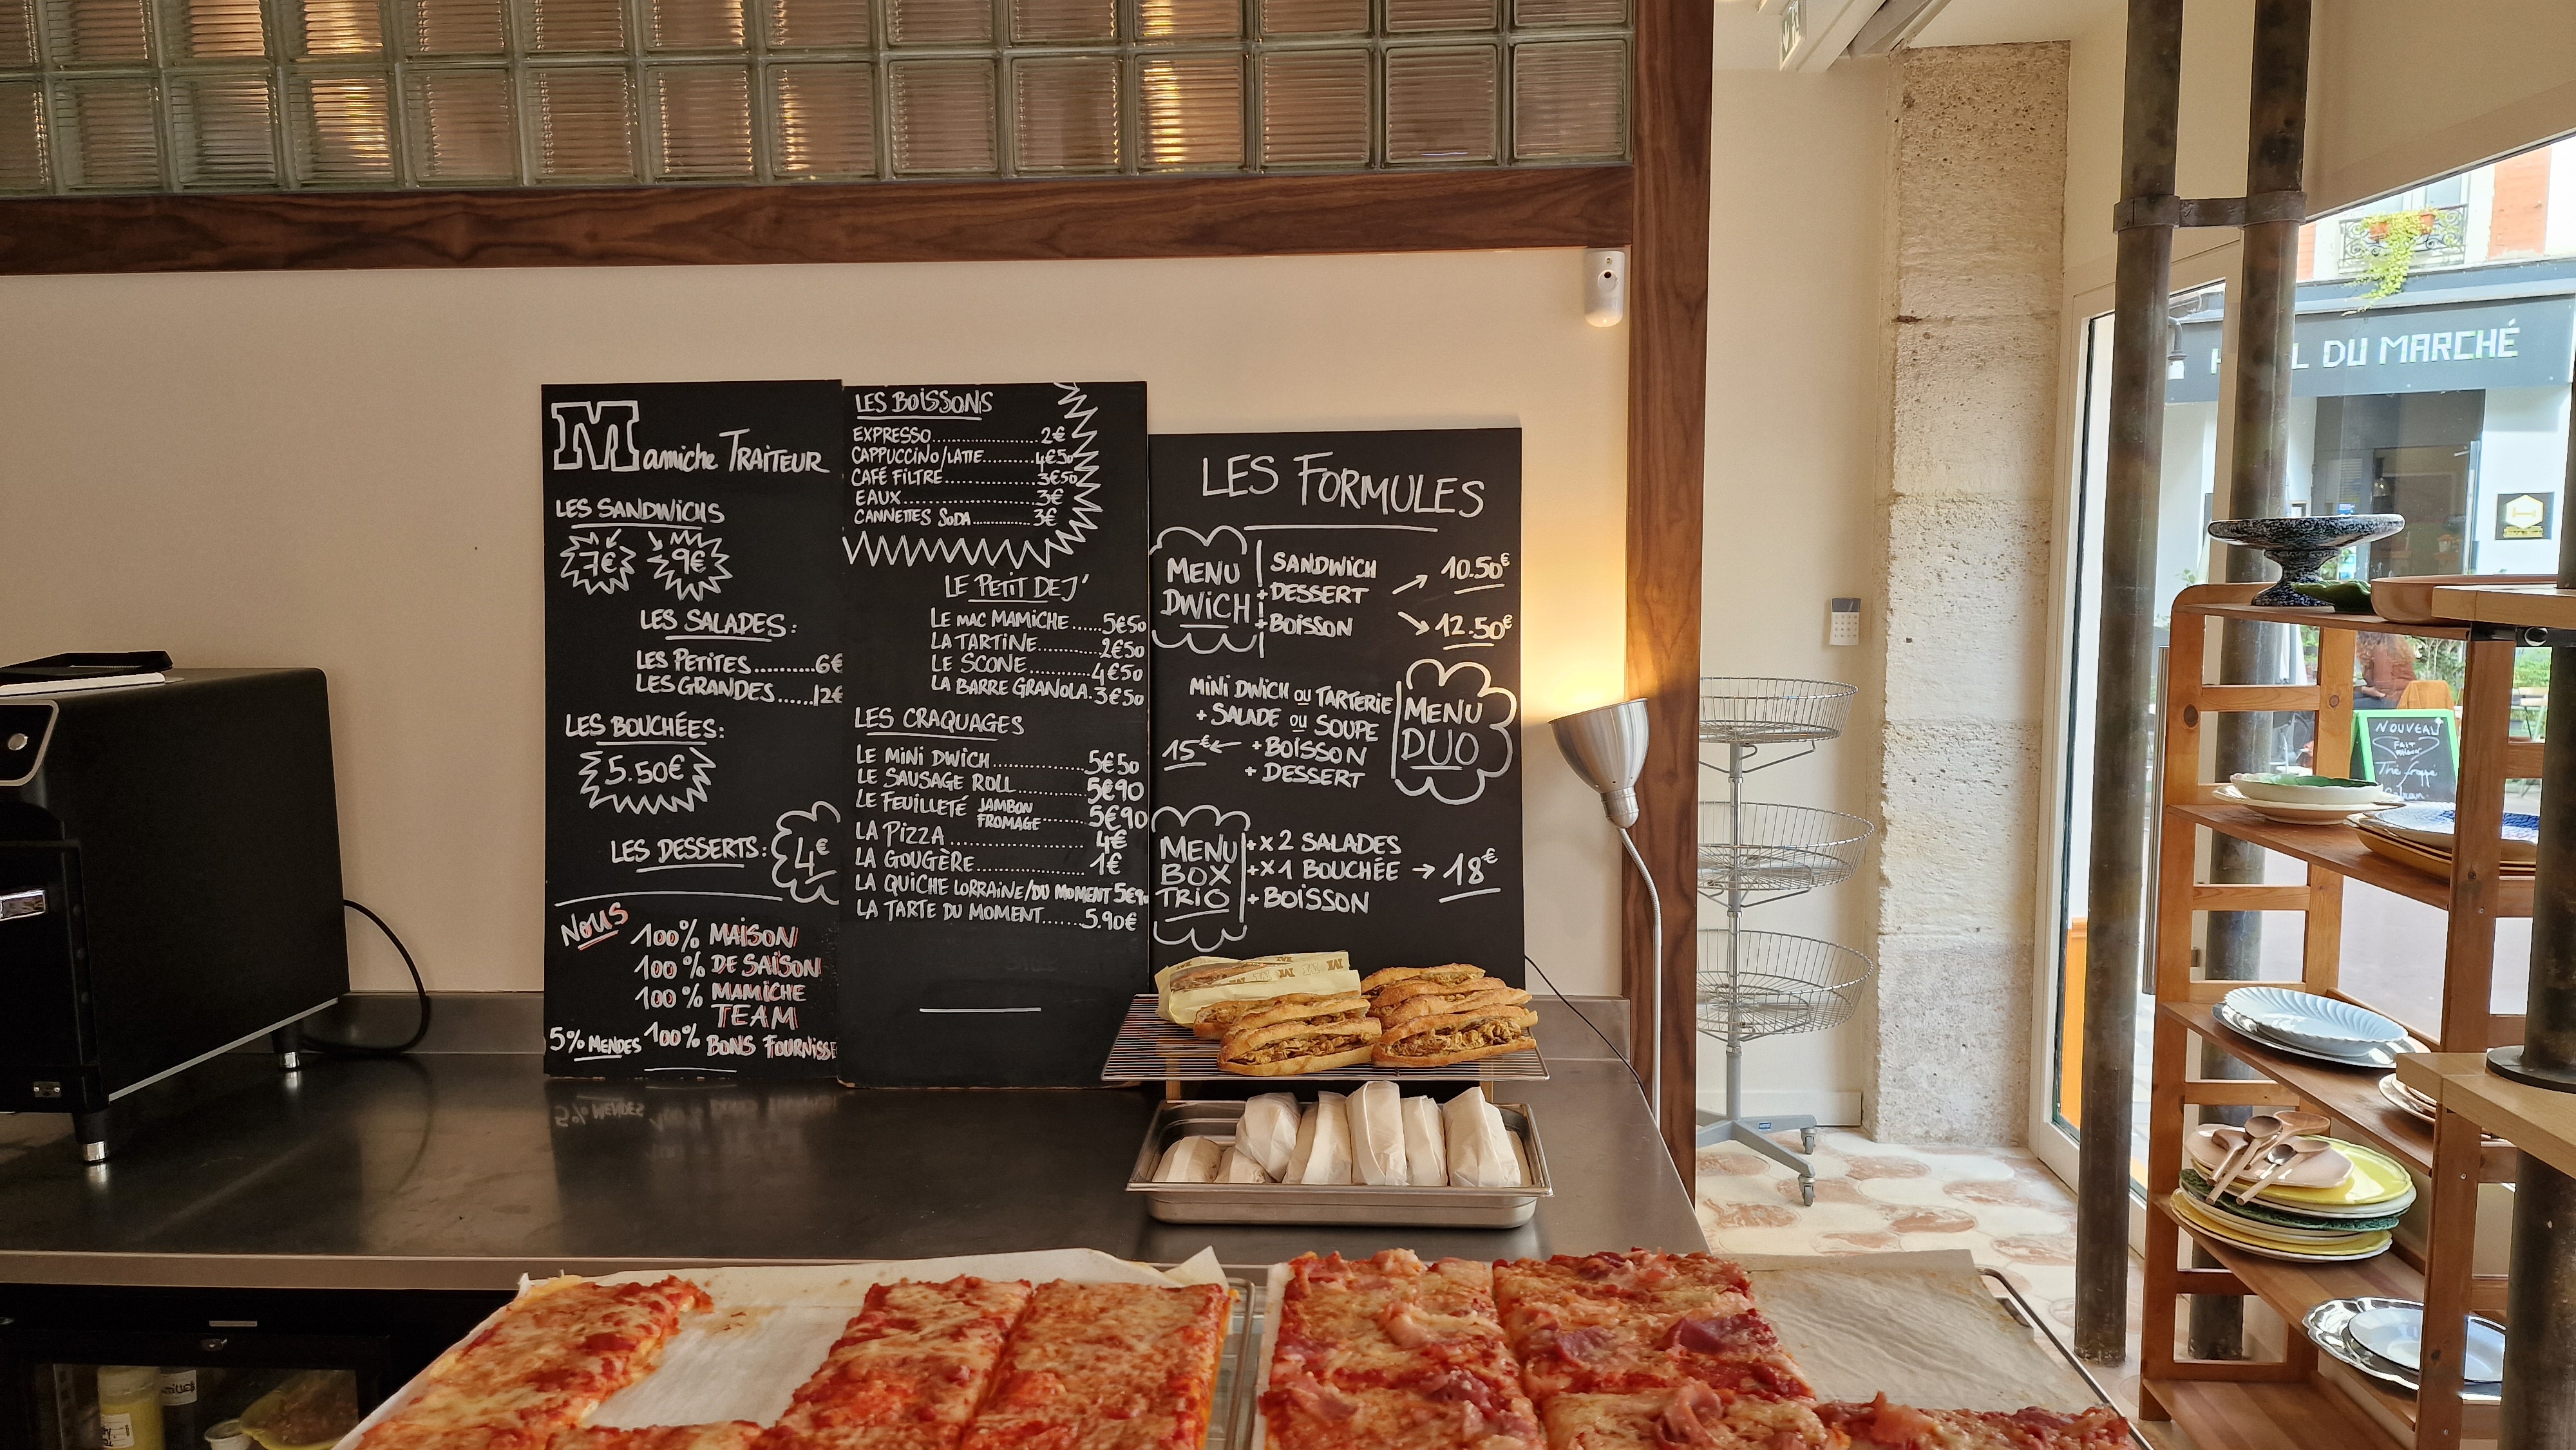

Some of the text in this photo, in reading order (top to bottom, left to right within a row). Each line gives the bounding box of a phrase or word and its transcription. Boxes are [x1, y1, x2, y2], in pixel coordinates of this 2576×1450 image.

[2323, 337, 2367, 368] DU
[2379, 318, 2521, 365] MARCHÉ
[855, 388, 993, 414] LES BOISSONS
[852, 426, 1065, 444] EXPRESSO 2€
[719, 428, 830, 473] TRAITEUR
[1035, 449, 1074, 472] 4€50
[851, 466, 1077, 486] CAFÉ FILTRE 3€50
[1203, 451, 1484, 518] LES FORMULES
[556, 498, 592, 518] LES
[856, 488, 1064, 506] EAUX 3€
[854, 507, 1057, 527] CANNETTES SODA 3€
[579, 551, 617, 576] 7€
[672, 548, 706, 574] 9€
[1168, 558, 1240, 585] MENU
[1270, 552, 1376, 578] SANDWICH
[1441, 552, 1510, 579] 10.50€
[945, 574, 970, 598] LE
[974, 572, 1028, 598] PETIT
[1269, 581, 1370, 604] DESSERT
[641, 609, 677, 630] LES
[1160, 588, 1251, 625] DWICH
[931, 607, 951, 628] LE
[992, 610, 1069, 630] MAMICHE
[1099, 613, 1146, 634] 5€50
[1269, 613, 1353, 637] BOISSON
[1434, 612, 1514, 641] 12.50€
[931, 632, 1144, 659] LA TARTINE 2€50
[637, 648, 842, 674] LES PETITES 6€
[932, 652, 1143, 686] LE SCONE 4€50
[636, 673, 676, 693] LES
[677, 676, 775, 702] GRANDES
[931, 675, 1144, 706] LA BARRE GRANOLA 3€50
[1190, 675, 1231, 697] MINI
[1234, 677, 1289, 699] DWICH
[1315, 686, 1394, 714] TARTERIE
[855, 707, 1025, 735] LES CRAQUAGES
[1211, 702, 1282, 728] SALADE
[1314, 714, 1379, 742] SOUPE
[1404, 697, 1482, 725] MENU
[565, 713, 606, 737] LES
[2375, 719, 2441, 736] NOUVEAU
[1264, 736, 1367, 766] BOISSON
[1401, 727, 1480, 766] DUO
[2394, 740, 2416, 749] FAIT
[605, 755, 685, 785] 5.50€
[857, 744, 1139, 775] LE MINI DWICH 5€50
[858, 767, 1144, 804] LE SAUSAGE ROLL 5€90
[1262, 762, 1365, 789] DESSERT
[856, 789, 1033, 818] LE FEUILLETÉ JAMBON
[977, 805, 1148, 831] FROMAGE 5€90
[856, 820, 1127, 854] LA PIZZA 4€
[1160, 833, 1237, 863] MENU
[1301, 833, 1403, 856] SALADES
[611, 839, 650, 863] LES
[795, 837, 830, 878] 4€
[855, 847, 1122, 875] LA GOUGÈRE 1€
[1160, 863, 1231, 886] BOX
[1303, 857, 1401, 881] BOUCHÉE
[1443, 848, 1498, 885] 18€
[855, 873, 876, 891] LA
[884, 872, 949, 896] QUICHE
[1055, 884, 1113, 904] MOMENT
[1155, 887, 1229, 909] TRIO
[1264, 883, 1369, 914] BOISSON
[561, 901, 629, 946] NOUS
[857, 899, 1137, 931] LA TARTE DU MOMENT 5.90€
[630, 917, 798, 952] 100% MAISON
[634, 950, 821, 980] 100% DE SAISON
[635, 981, 806, 1010] 100% MAMICHE
[711, 1004, 798, 1030] TEAM
[550, 1027, 641, 1054] 5% MENDES
[644, 1021, 700, 1048] 100%
[706, 1035, 756, 1056] BONS
